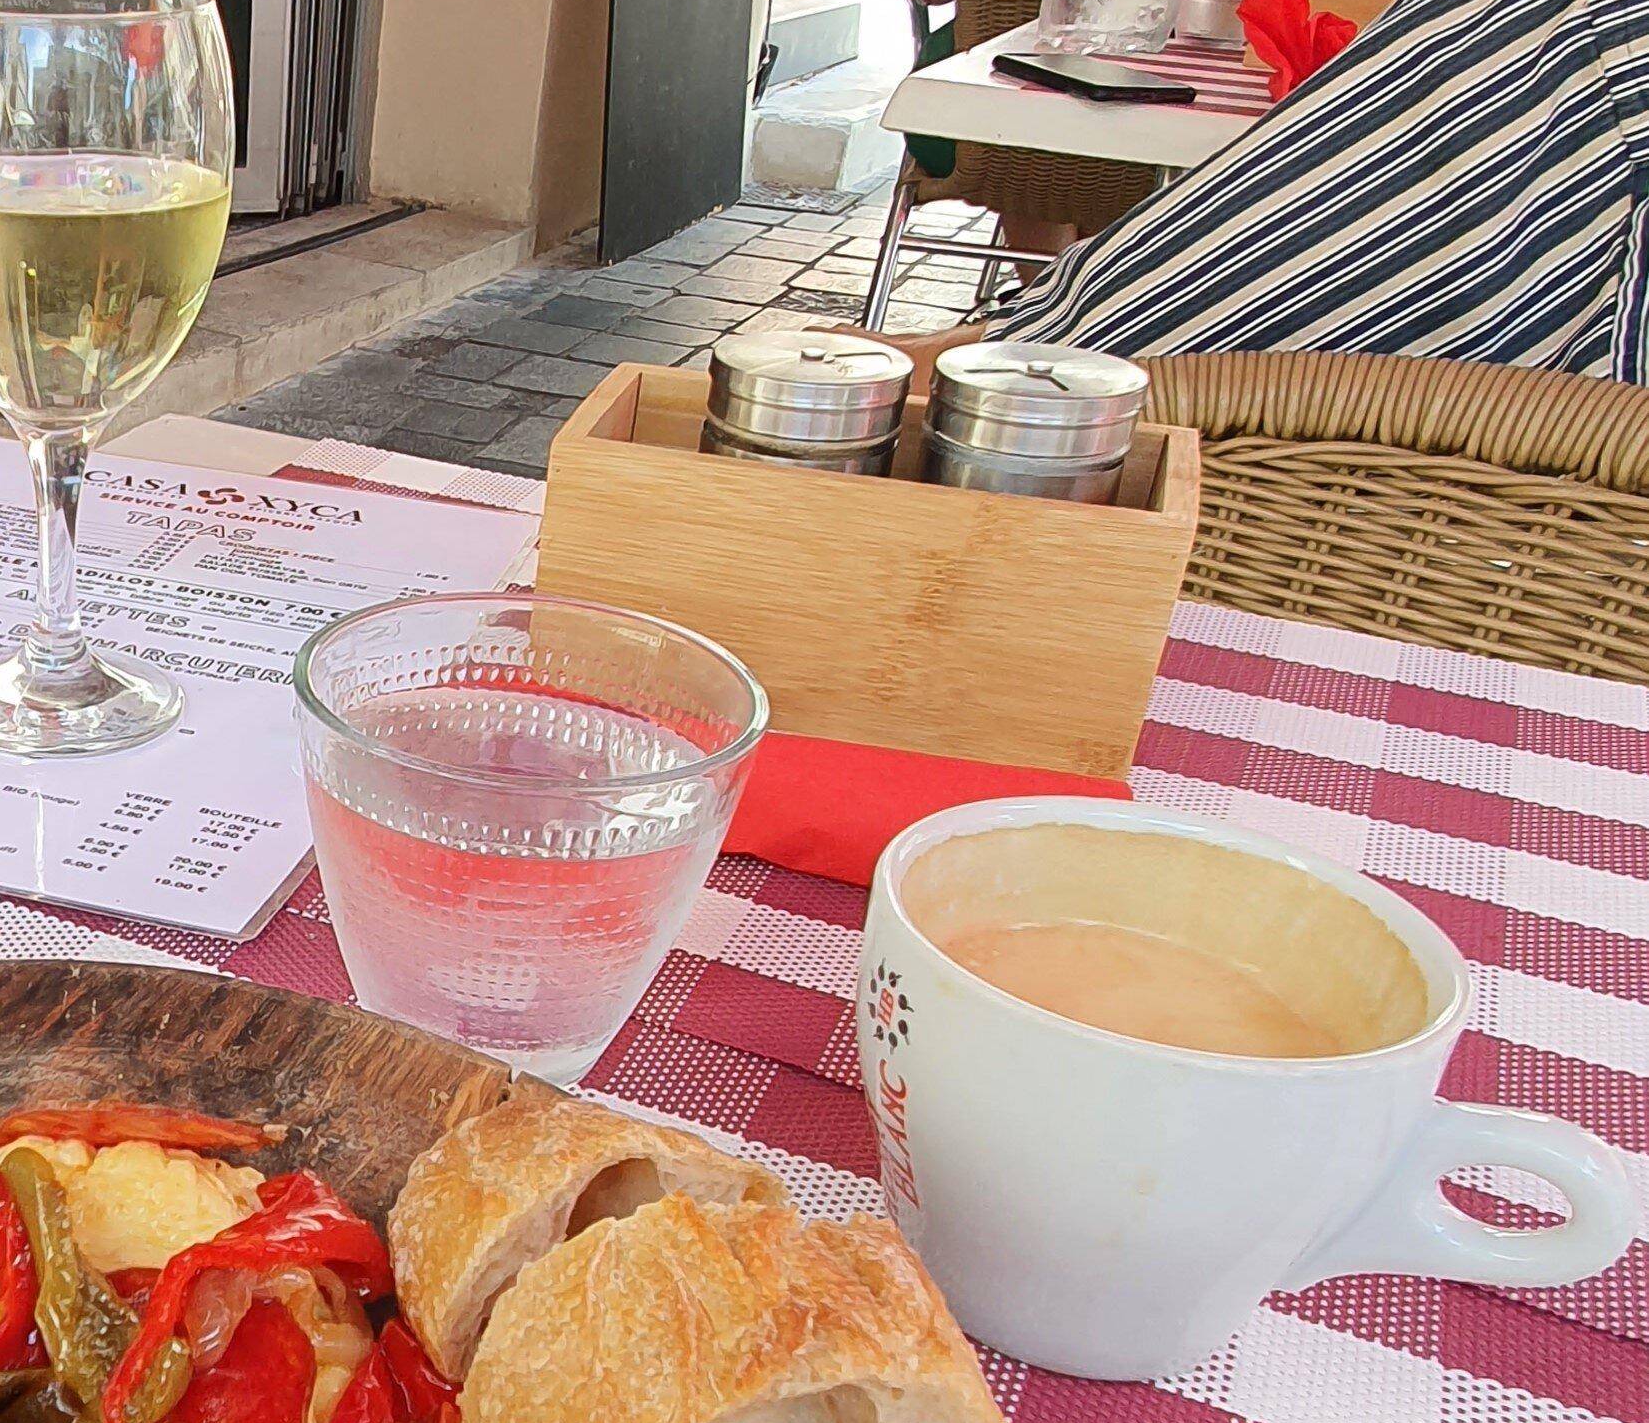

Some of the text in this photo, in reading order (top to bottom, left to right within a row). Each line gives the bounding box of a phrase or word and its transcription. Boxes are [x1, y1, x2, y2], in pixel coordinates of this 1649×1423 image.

[84, 470, 363, 524] CASA XYCA
[99, 492, 316, 532] SERVICE AU COMPTOIR
[126, 510, 257, 542] TAPAS
[248, 573, 298, 583] TOMATE
[177, 586, 270, 606] BOISSON
[282, 604, 325, 615] 7.00
[144, 626, 207, 640] BEIGNETS
[3, 785, 28, 795] BIO
[119, 801, 152, 812] 4.50
[208, 820, 246, 831] 17.00
[125, 791, 283, 829] VERRE BOUTEILLE
[166, 863, 207, 876] 17.00
[172, 856, 214, 869] 20.00
